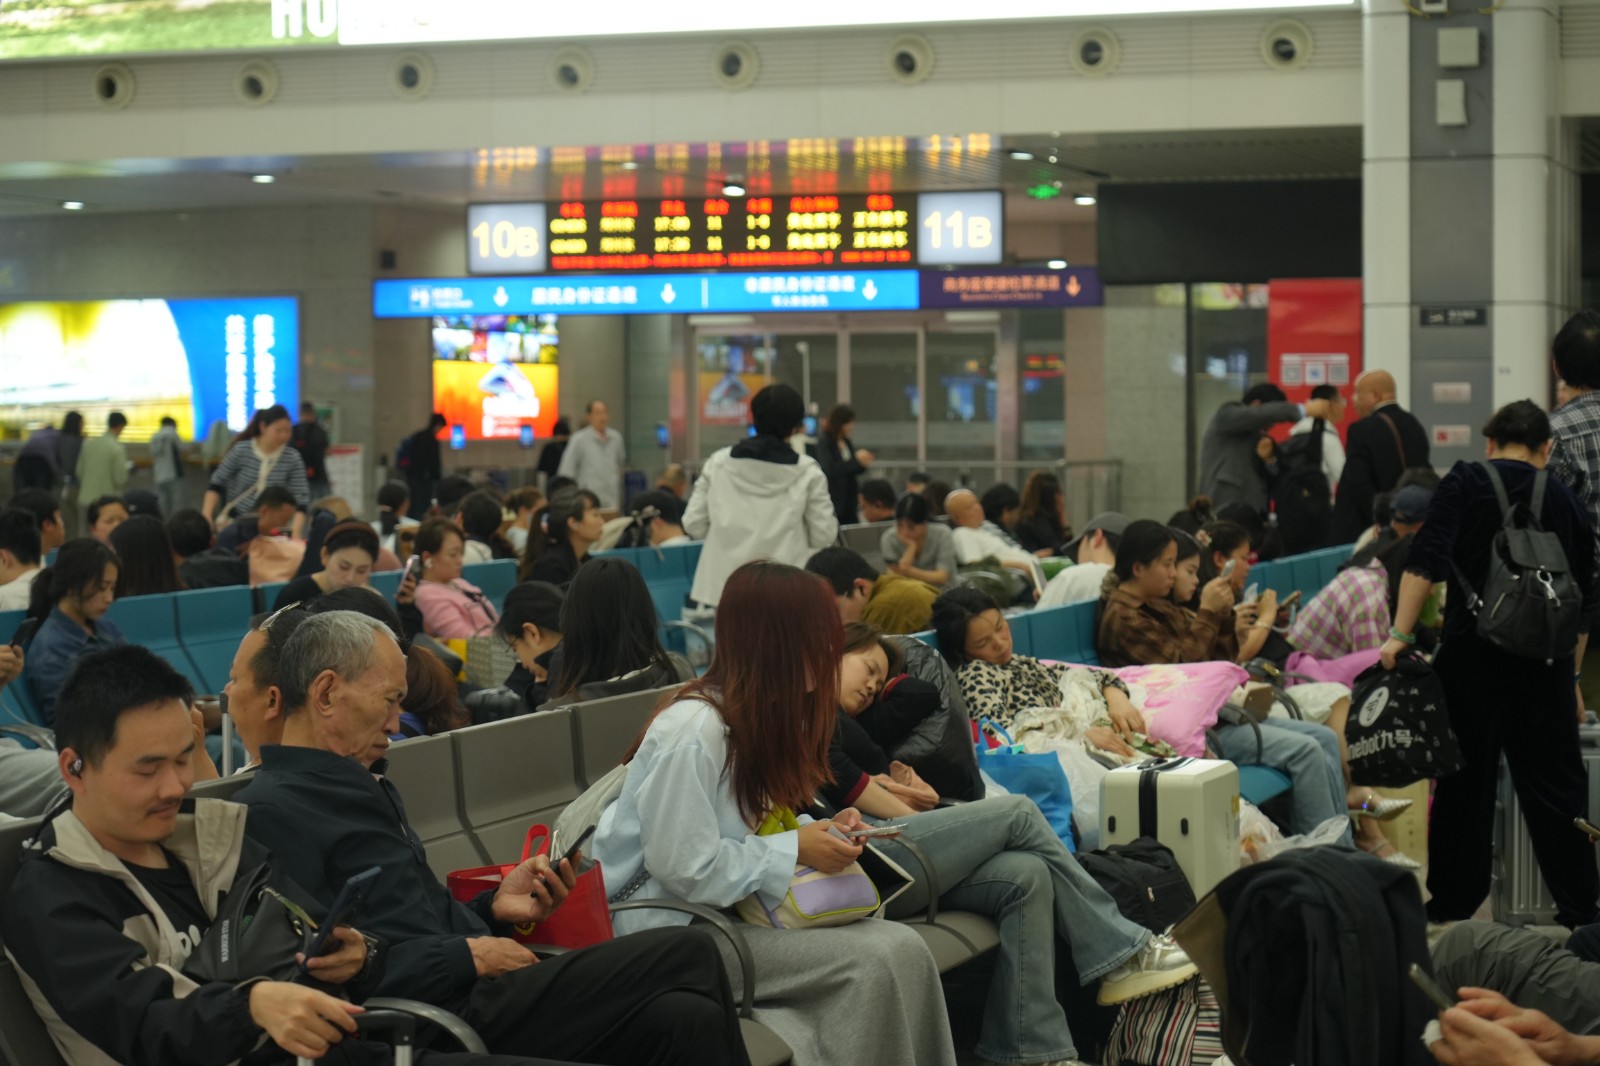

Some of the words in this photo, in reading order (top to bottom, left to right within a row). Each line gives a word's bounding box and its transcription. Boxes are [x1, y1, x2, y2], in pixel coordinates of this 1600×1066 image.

[472, 220, 540, 259] 10B
[923, 210, 993, 249] 11B
[1380, 729, 1414, 750] 九号
